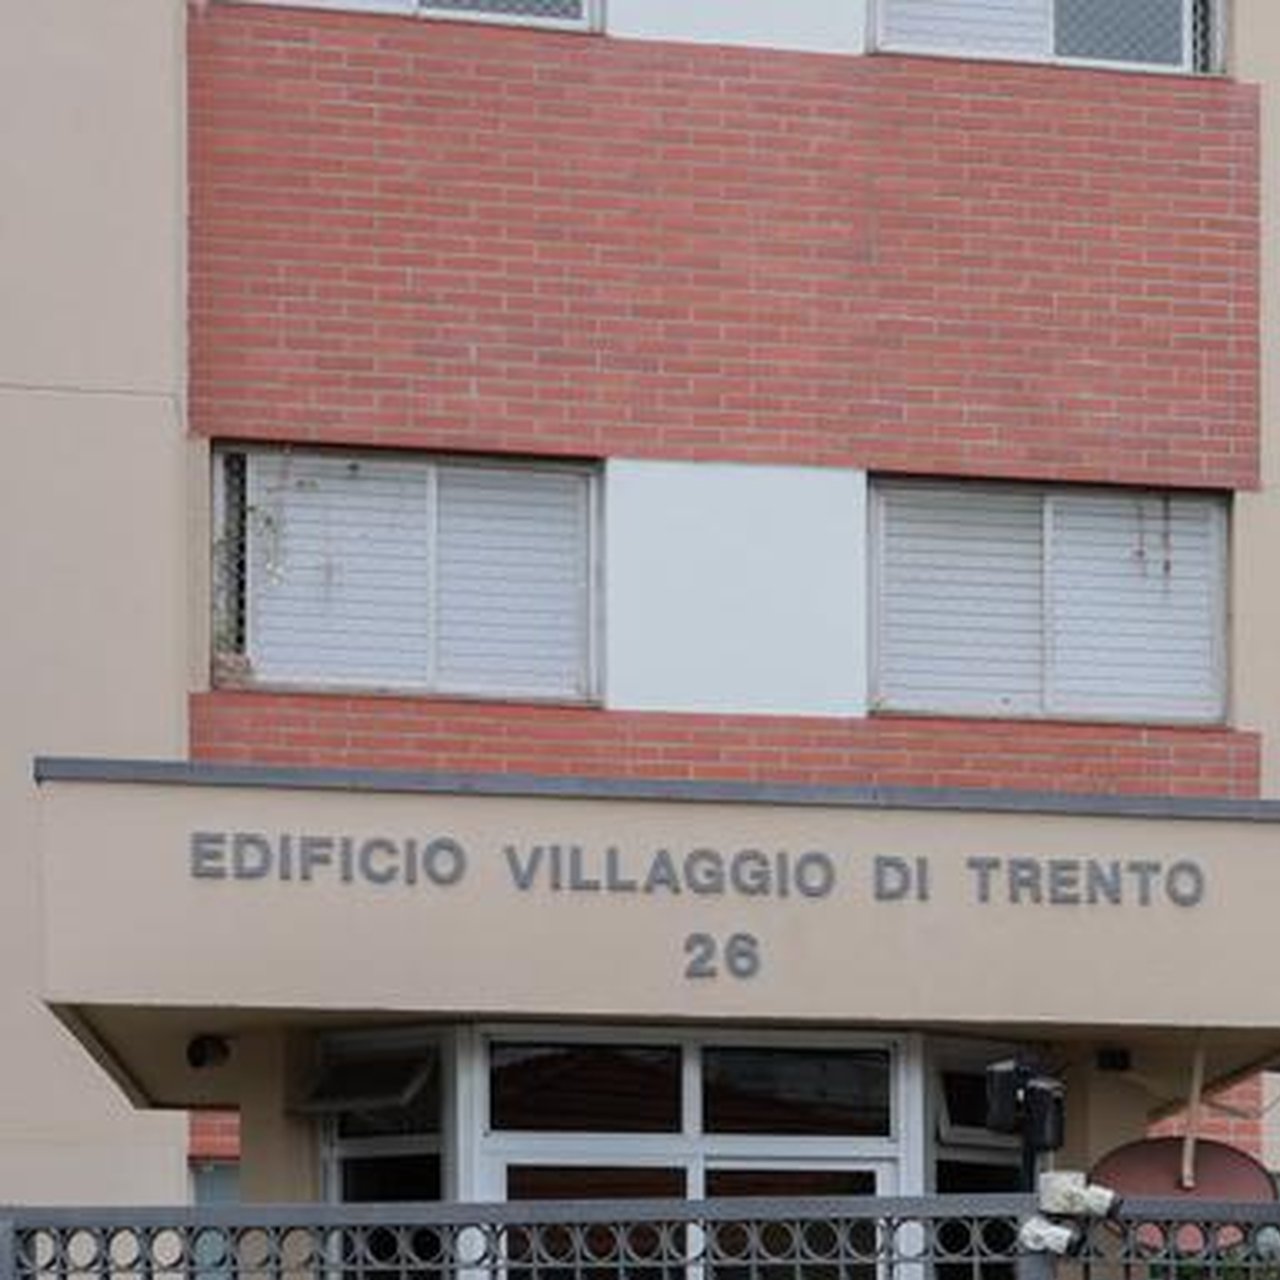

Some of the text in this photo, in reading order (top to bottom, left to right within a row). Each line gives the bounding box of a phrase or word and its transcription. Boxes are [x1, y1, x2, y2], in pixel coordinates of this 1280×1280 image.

[190, 831, 1205, 909] EDIFICIO VILLAGGIO DI TRENTO
[682, 932, 761, 981] 26
